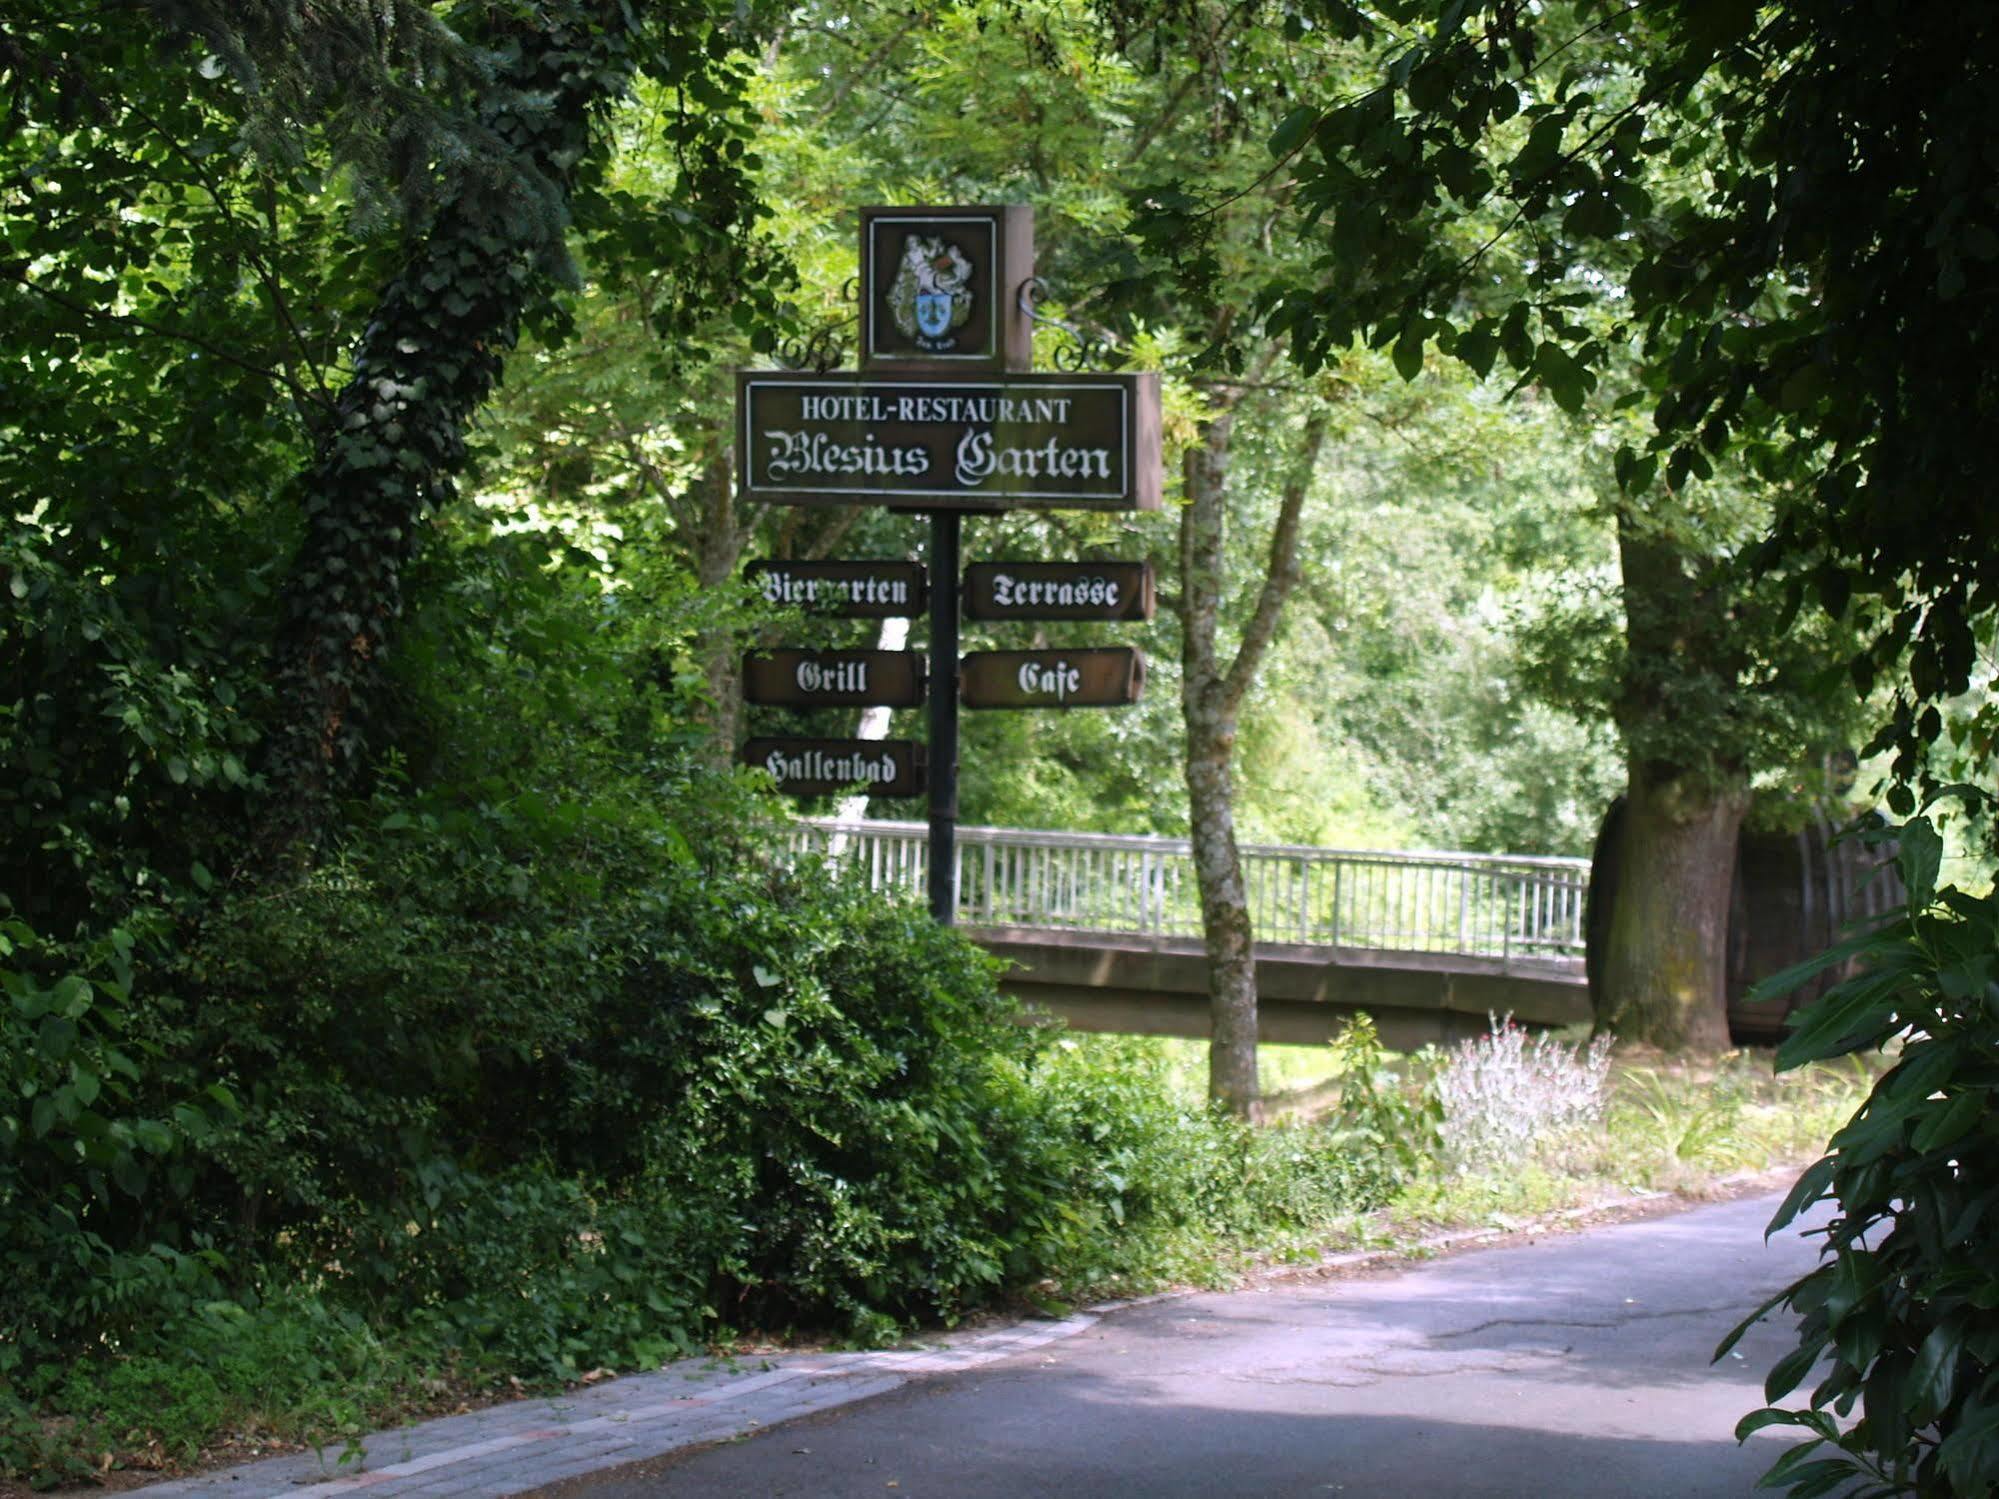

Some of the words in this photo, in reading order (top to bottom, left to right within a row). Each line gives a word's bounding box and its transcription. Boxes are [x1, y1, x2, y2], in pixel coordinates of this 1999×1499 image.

[802, 396, 1071, 424] HOTEL-RESTAURANT
[764, 429, 929, 482] Blesius
[955, 426, 1111, 486] Garten
[763, 572, 907, 605] Bierrten
[993, 574, 1120, 607] Terrasse
[797, 661, 868, 693] Grill
[766, 749, 896, 785] Hallenbad
